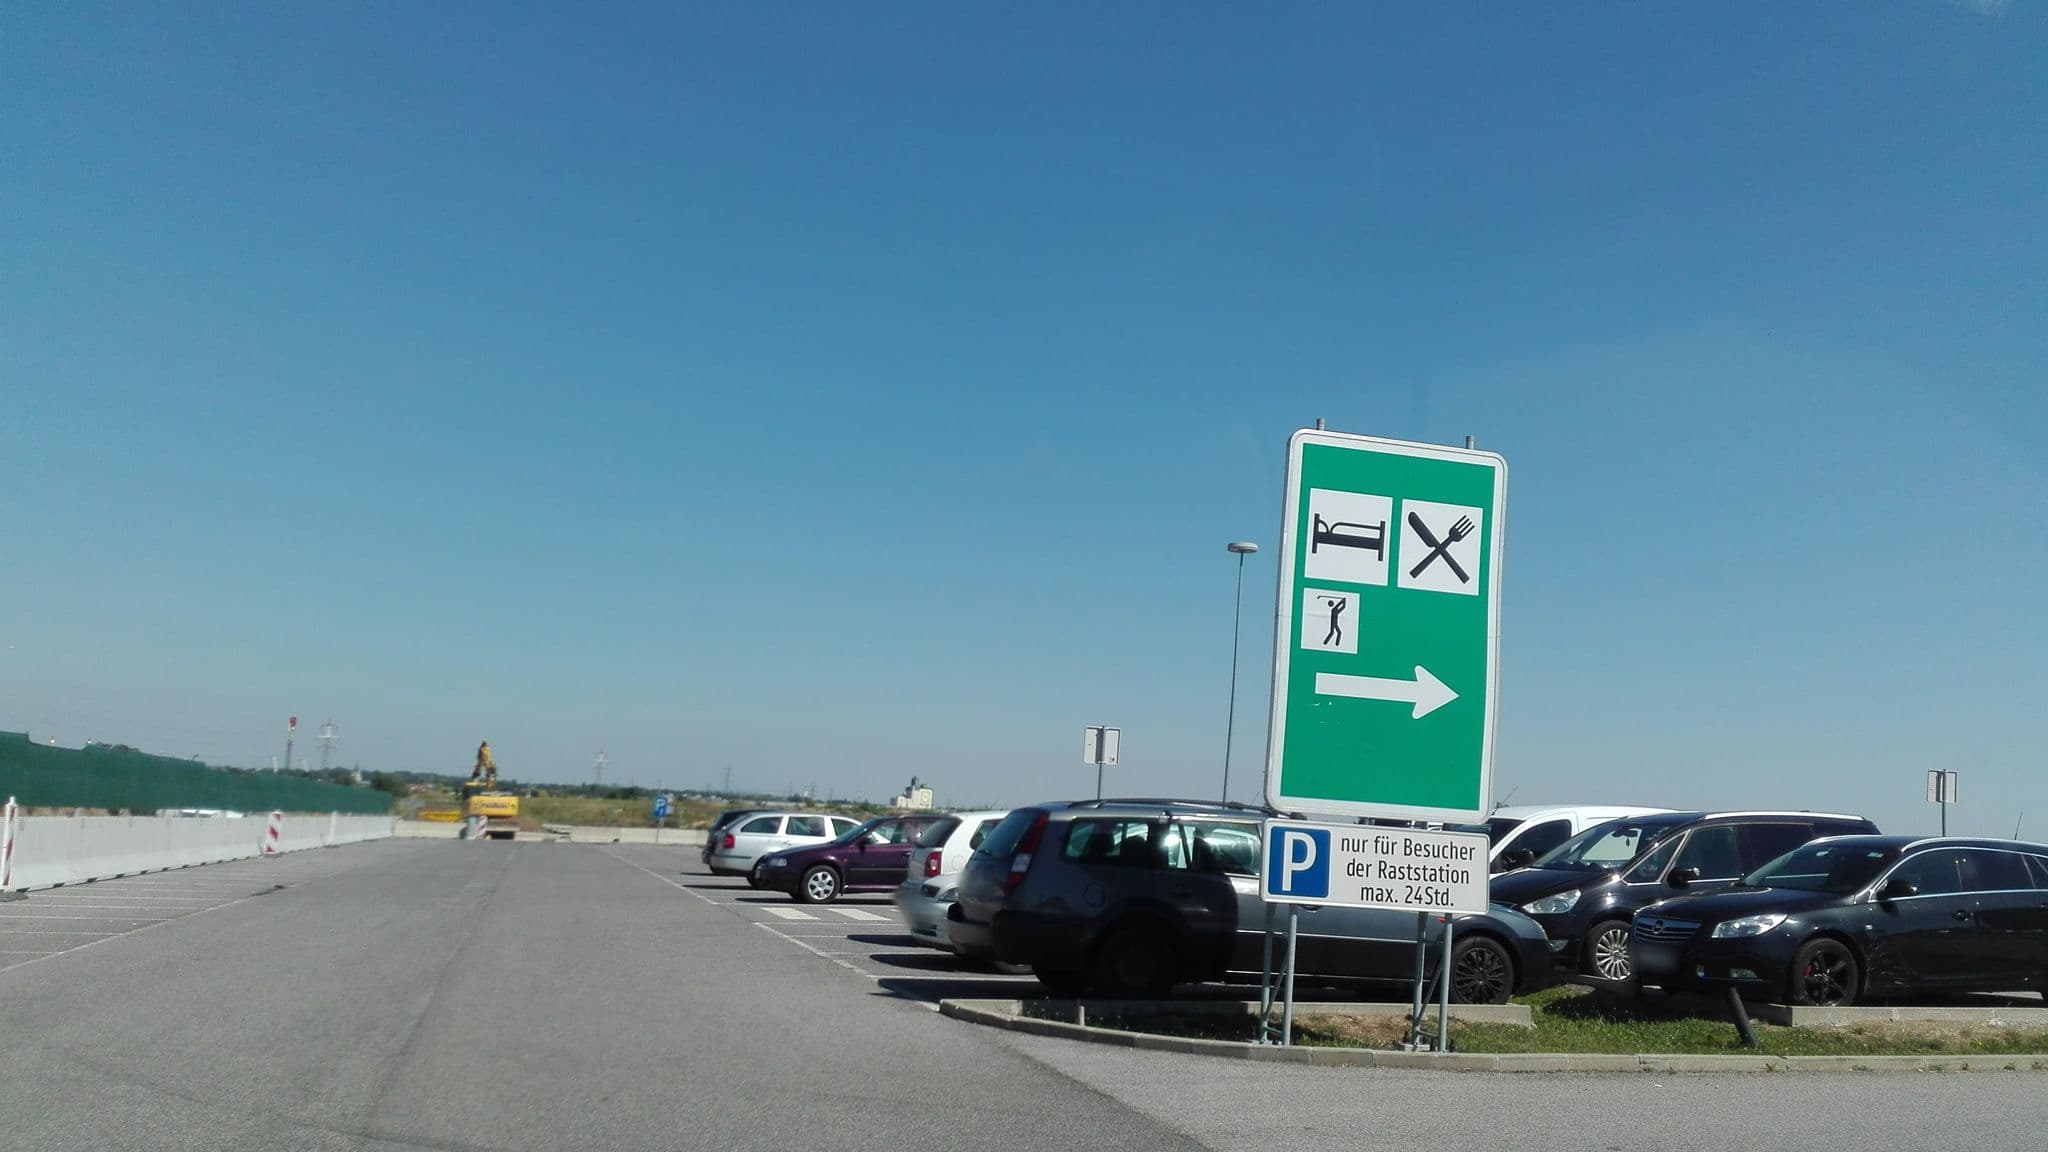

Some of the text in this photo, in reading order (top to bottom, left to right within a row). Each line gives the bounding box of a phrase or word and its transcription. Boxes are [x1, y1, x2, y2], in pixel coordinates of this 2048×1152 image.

[656, 798, 666, 811] P
[1341, 835, 1476, 861] nur für Besucher
[1282, 831, 1317, 891] P
[1346, 859, 1470, 884] der Raststation
[1360, 885, 1398, 903] max.
